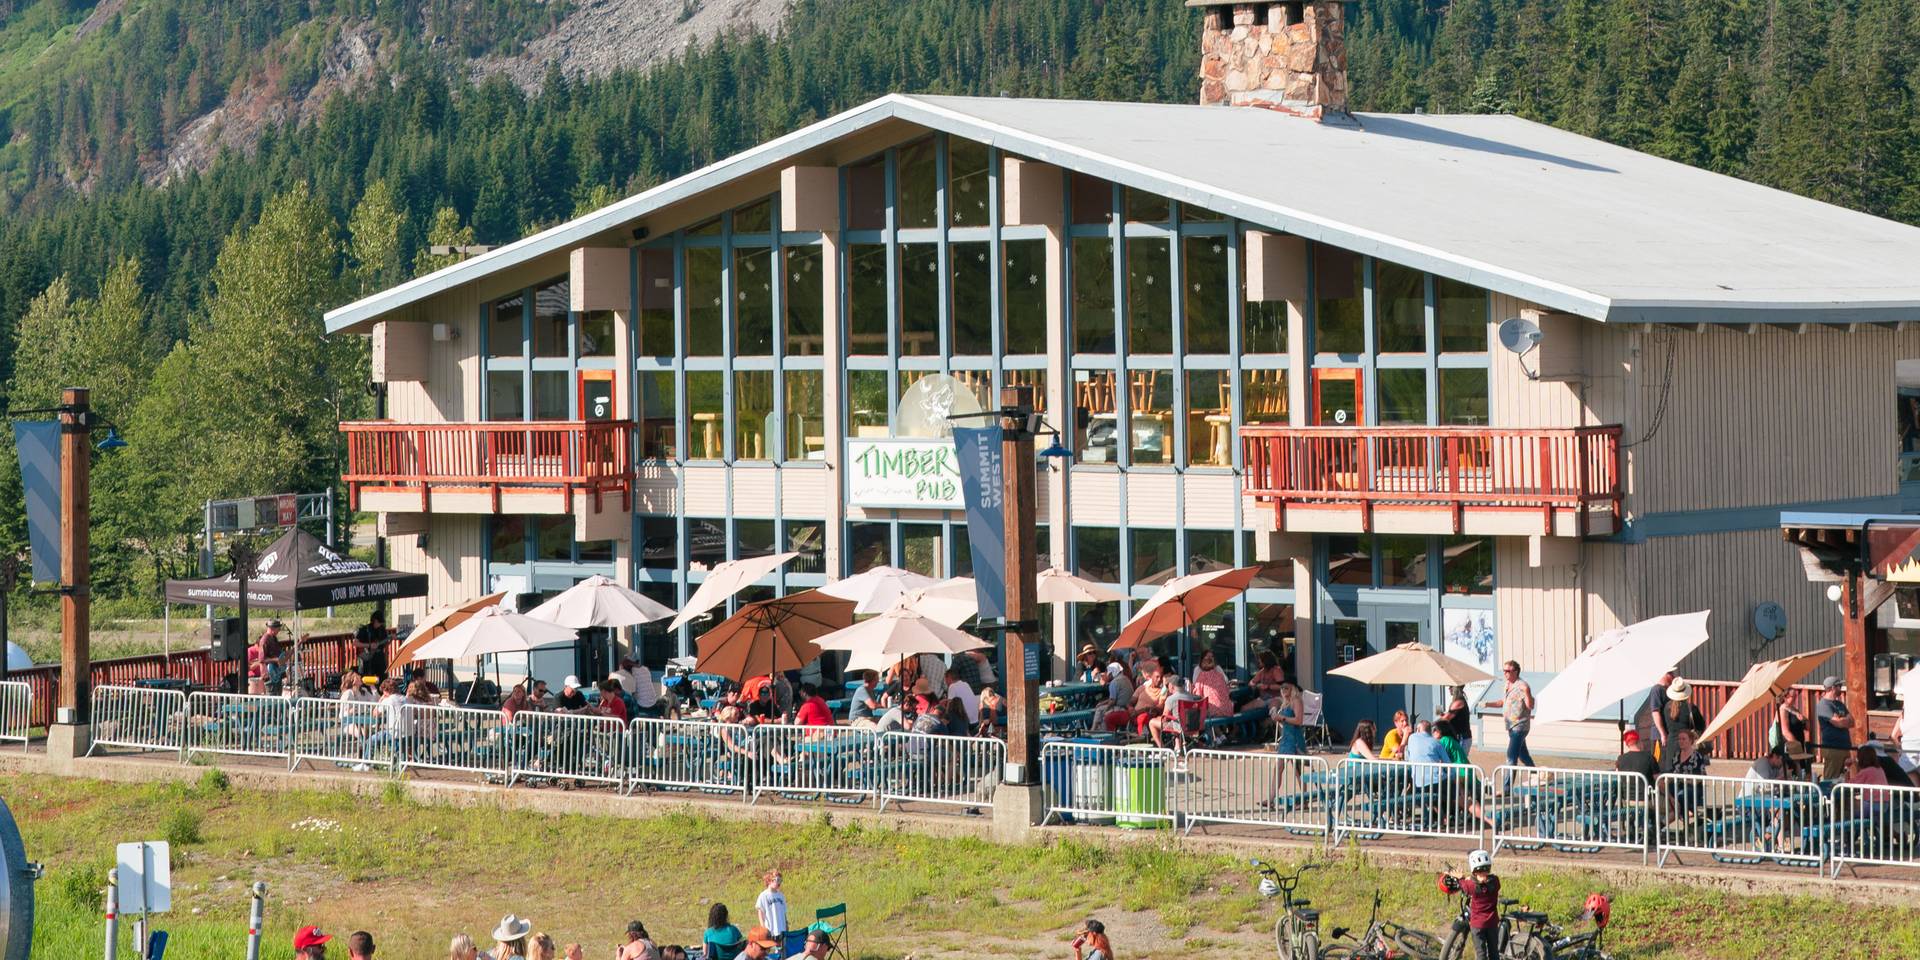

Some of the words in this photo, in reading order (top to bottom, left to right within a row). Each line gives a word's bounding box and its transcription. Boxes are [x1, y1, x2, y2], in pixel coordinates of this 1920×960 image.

[856, 445, 960, 478] TIMBER
[978, 433, 991, 508] SUMMIT
[916, 479, 956, 501] PUB
[991, 451, 1001, 508] WEST
[282, 511, 293, 521] WAY
[308, 563, 332, 573] THE
[332, 561, 371, 570] SUMMIT
[331, 586, 347, 601] YOUR
[349, 585, 365, 598] HOME
[367, 582, 398, 596] MOUNTAIN
